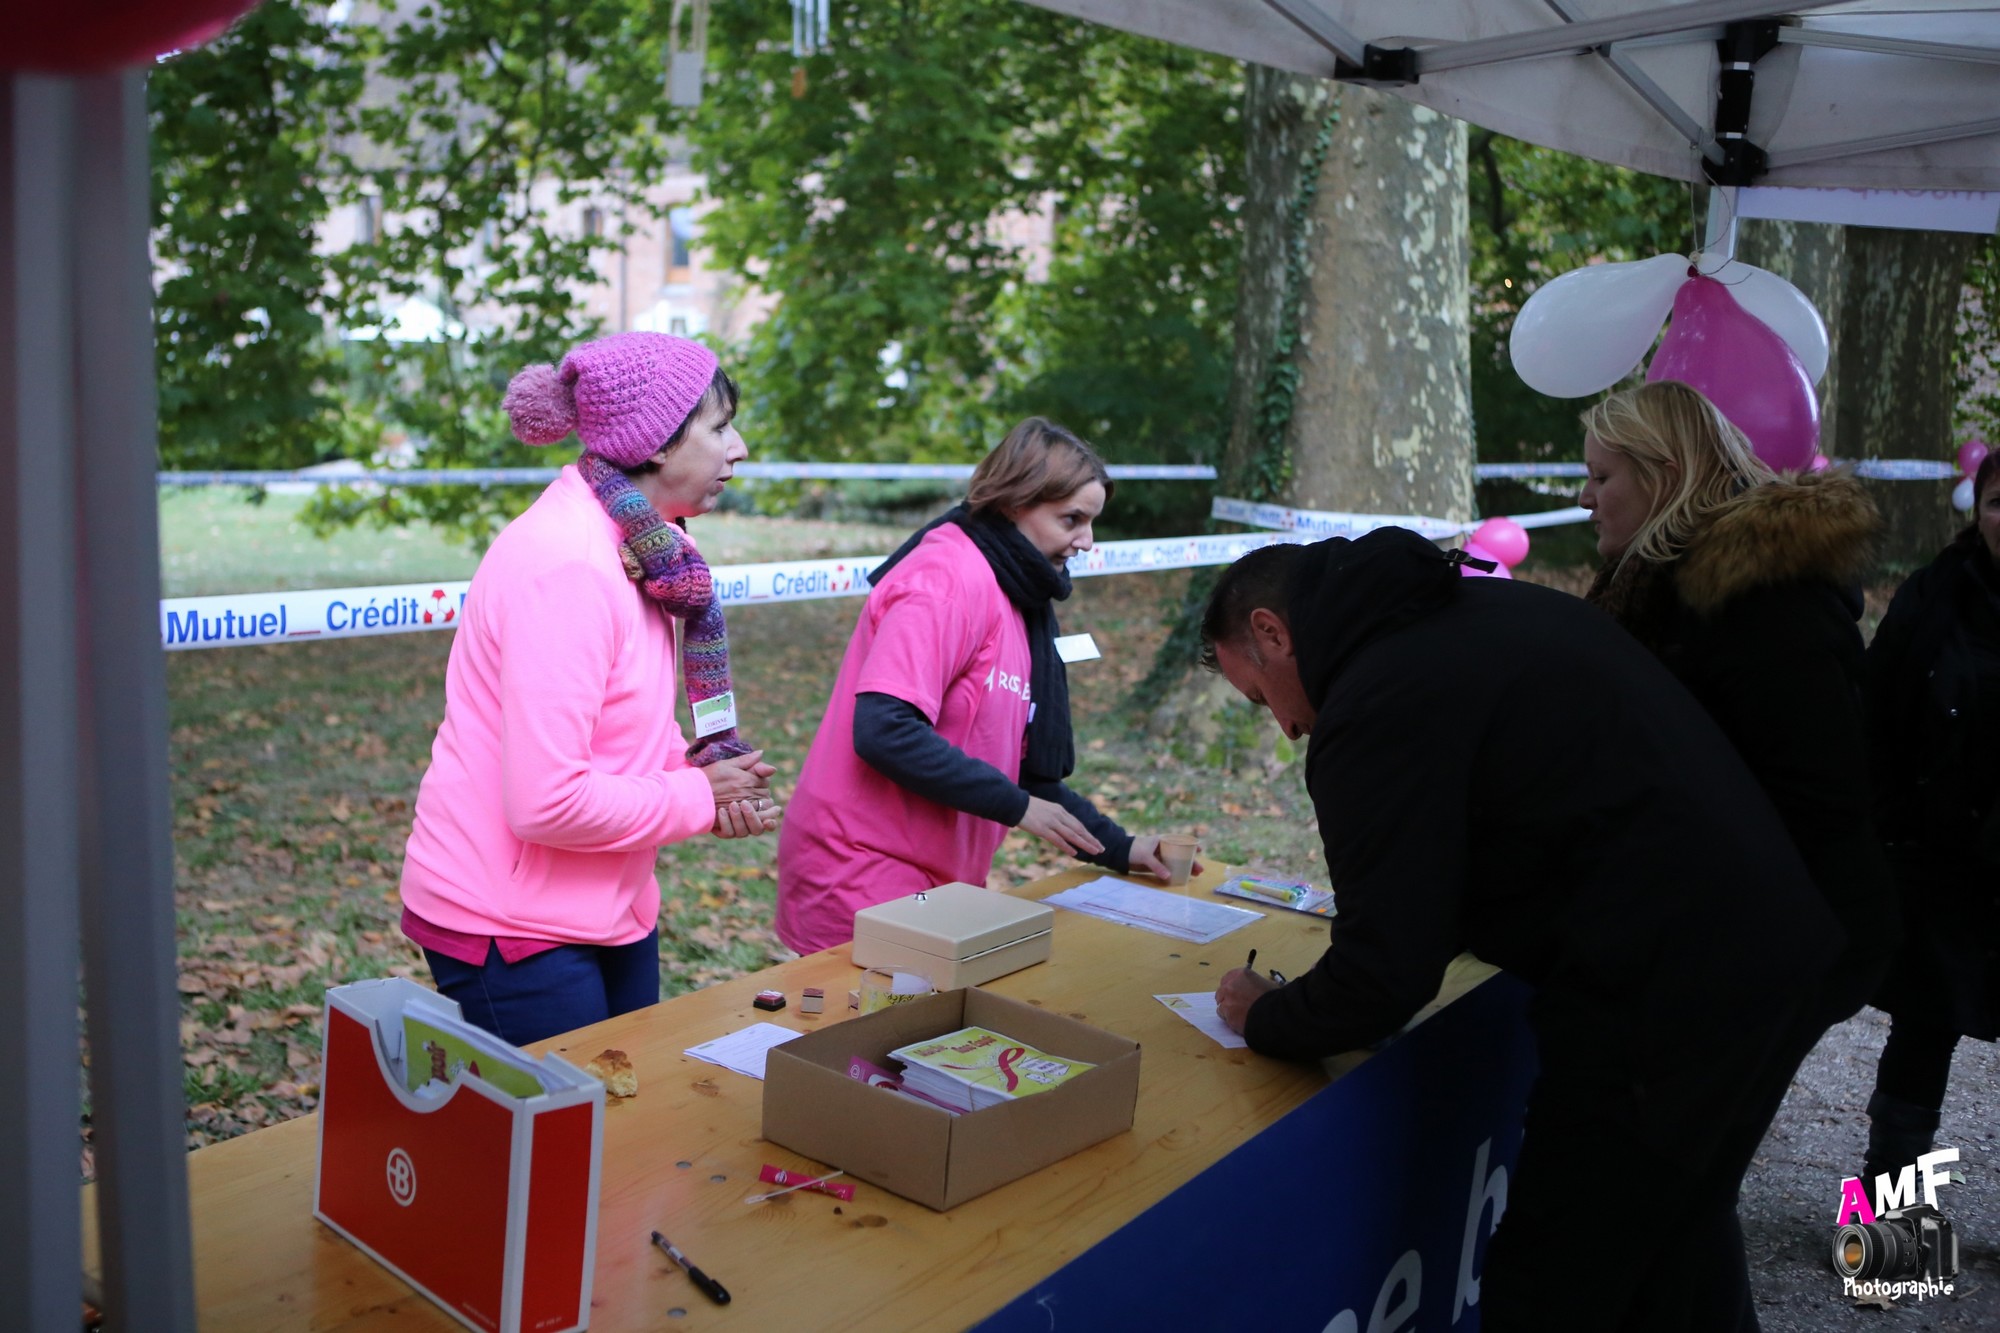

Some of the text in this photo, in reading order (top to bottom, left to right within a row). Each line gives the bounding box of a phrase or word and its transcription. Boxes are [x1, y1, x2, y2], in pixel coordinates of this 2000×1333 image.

[713, 574, 750, 601] tuel
[772, 570, 829, 596] Crédit
[166, 603, 288, 645] Mutuel
[326, 596, 419, 632] Crédit
